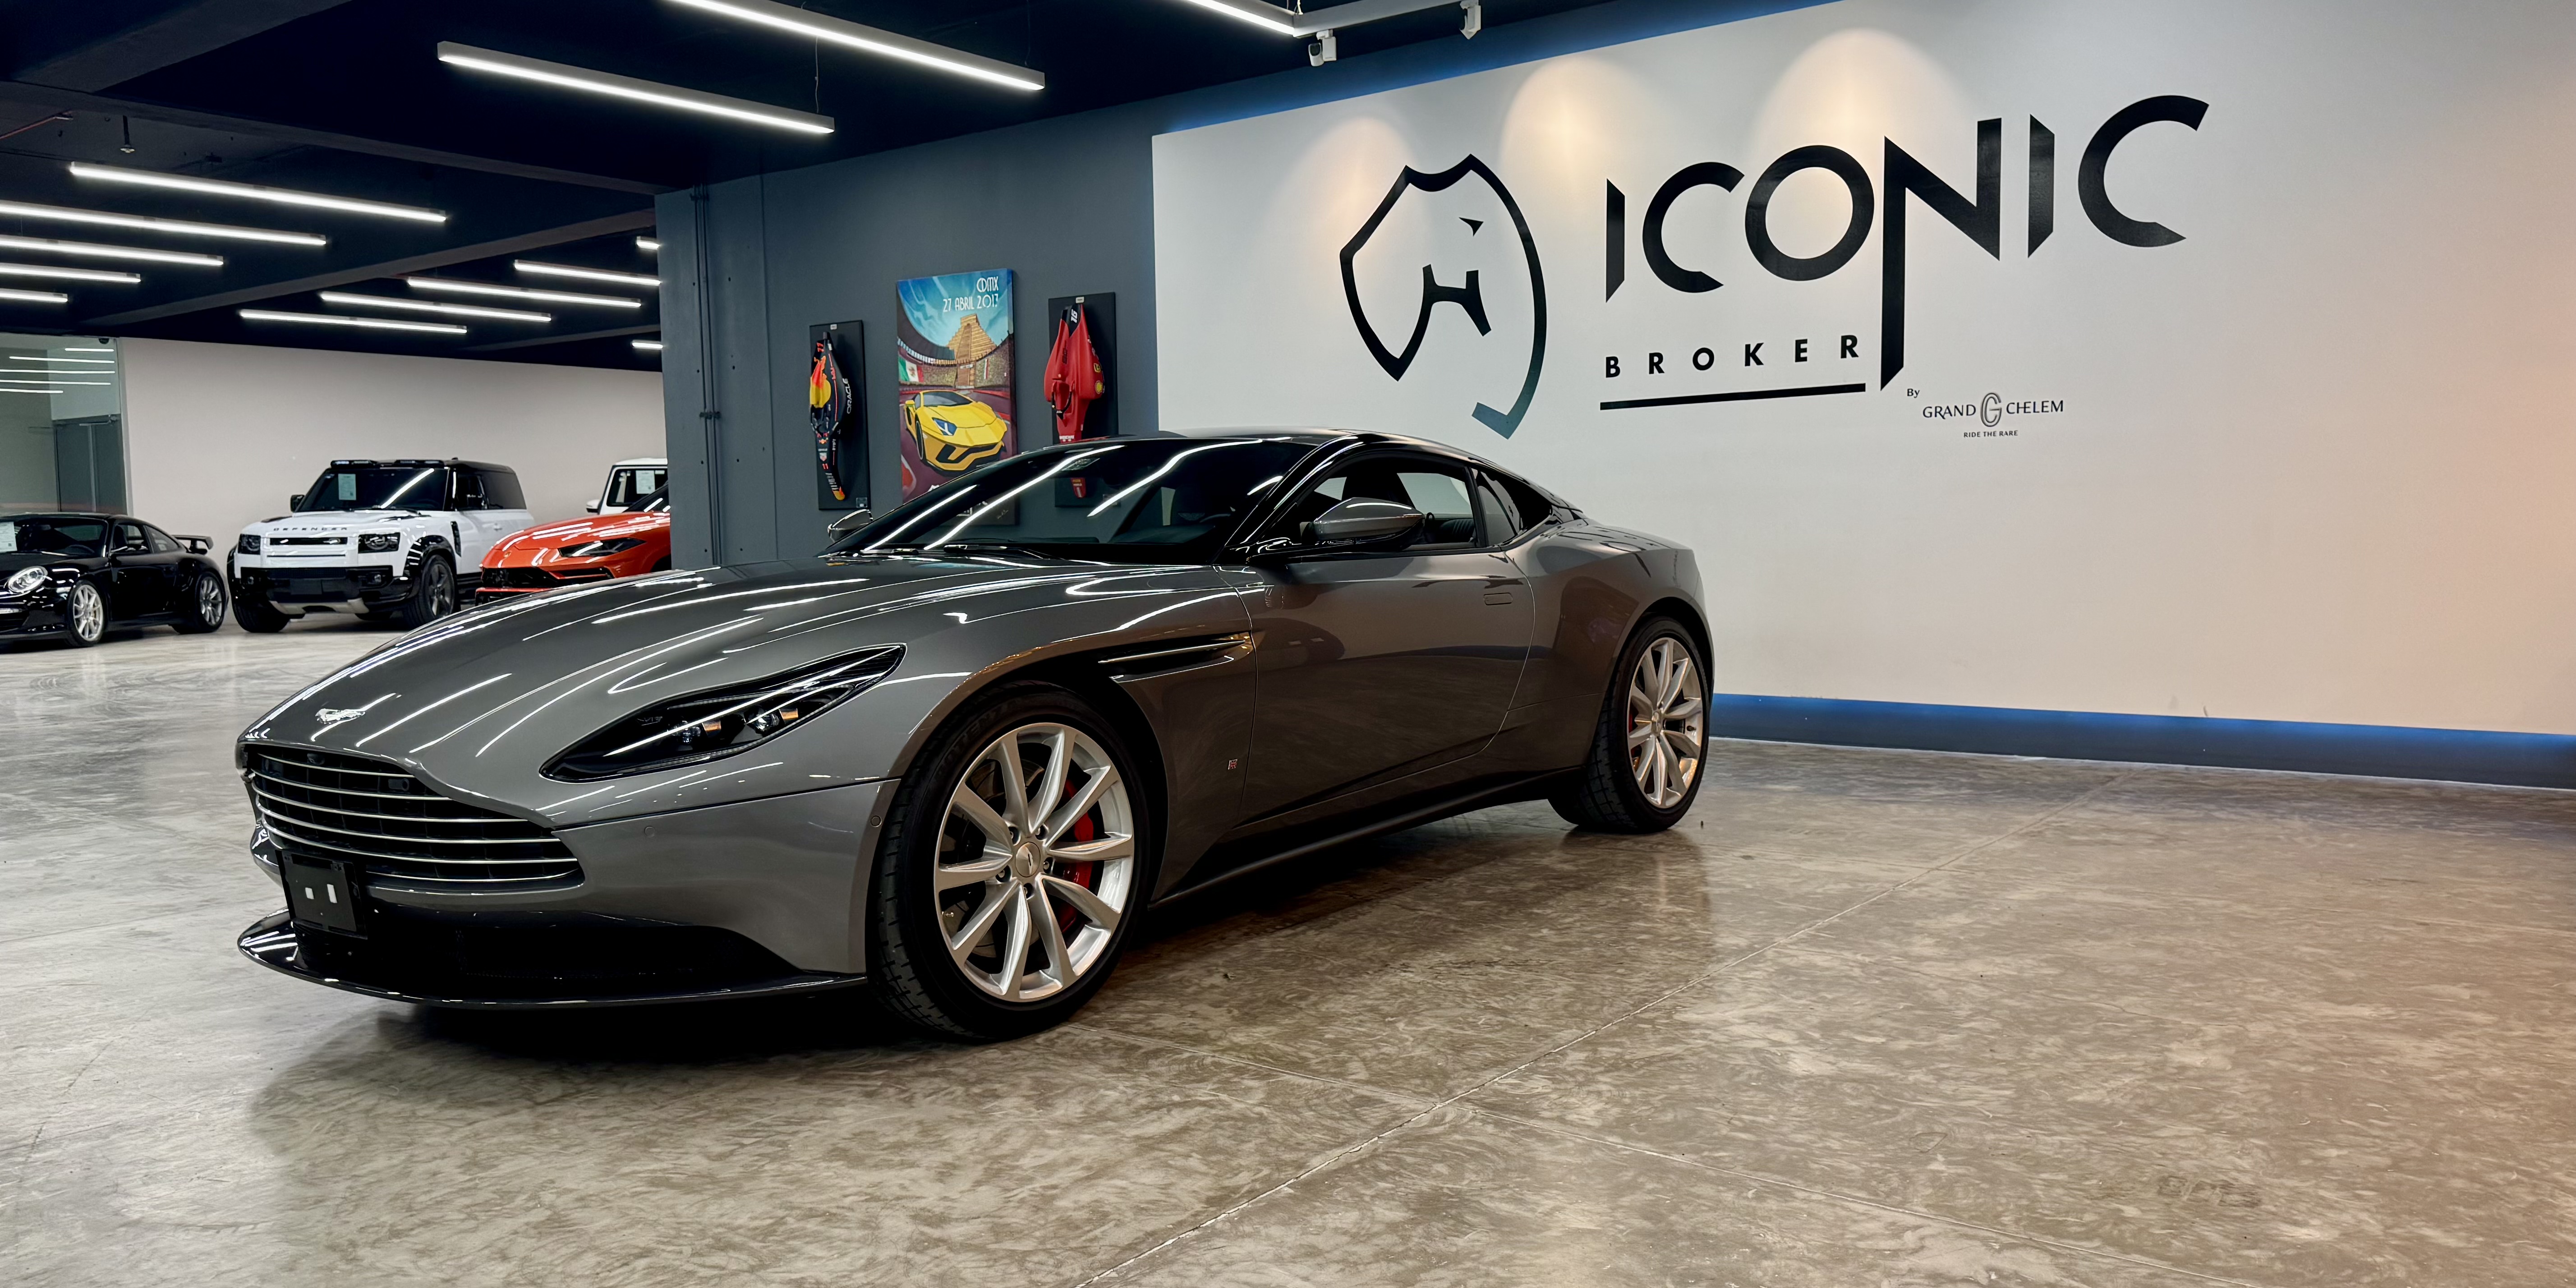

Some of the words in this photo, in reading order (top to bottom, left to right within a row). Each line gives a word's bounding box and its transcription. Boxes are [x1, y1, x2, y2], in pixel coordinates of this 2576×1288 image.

[1605, 95, 2210, 391] ICONIC
[976, 276, 999, 293] CDMX
[943, 298, 952, 312] 27
[955, 296, 975, 311] ABRIL
[977, 294, 998, 309] 2017
[1071, 309, 1077, 323] 16
[1605, 335, 1859, 378] BROKER
[842, 378, 852, 414] ORACLE
[1907, 388, 1920, 398] By
[1923, 404, 1976, 419] GRAND
[2006, 400, 2064, 414] CHELEM
